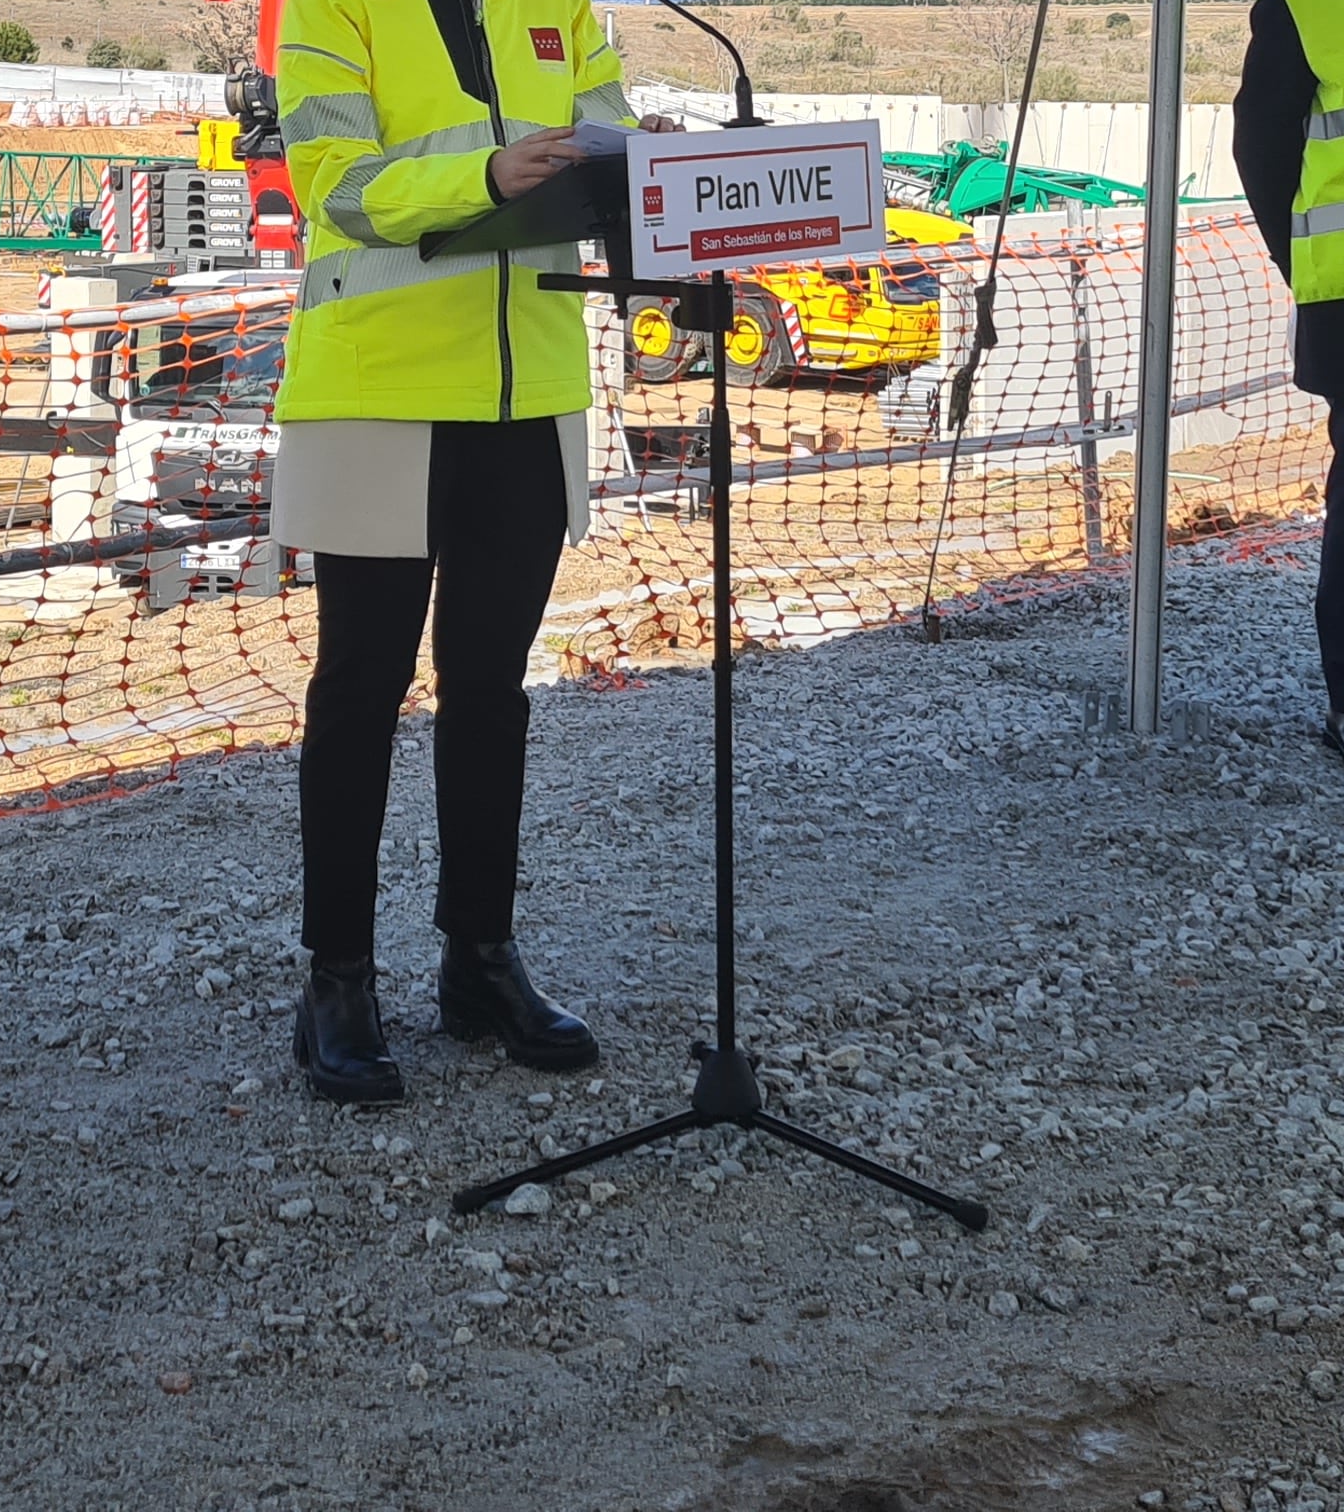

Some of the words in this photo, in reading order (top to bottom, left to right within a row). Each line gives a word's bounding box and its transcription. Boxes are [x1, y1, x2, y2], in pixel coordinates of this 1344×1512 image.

[695, 174, 760, 213] Plan
[768, 165, 833, 205] VIVE
[701, 236, 721, 251] San
[723, 231, 772, 248] Sebastián
[774, 229, 786, 242] de
[788, 227, 802, 241] los
[804, 225, 833, 241] Reyes
[194, 477, 262, 493] MAN
